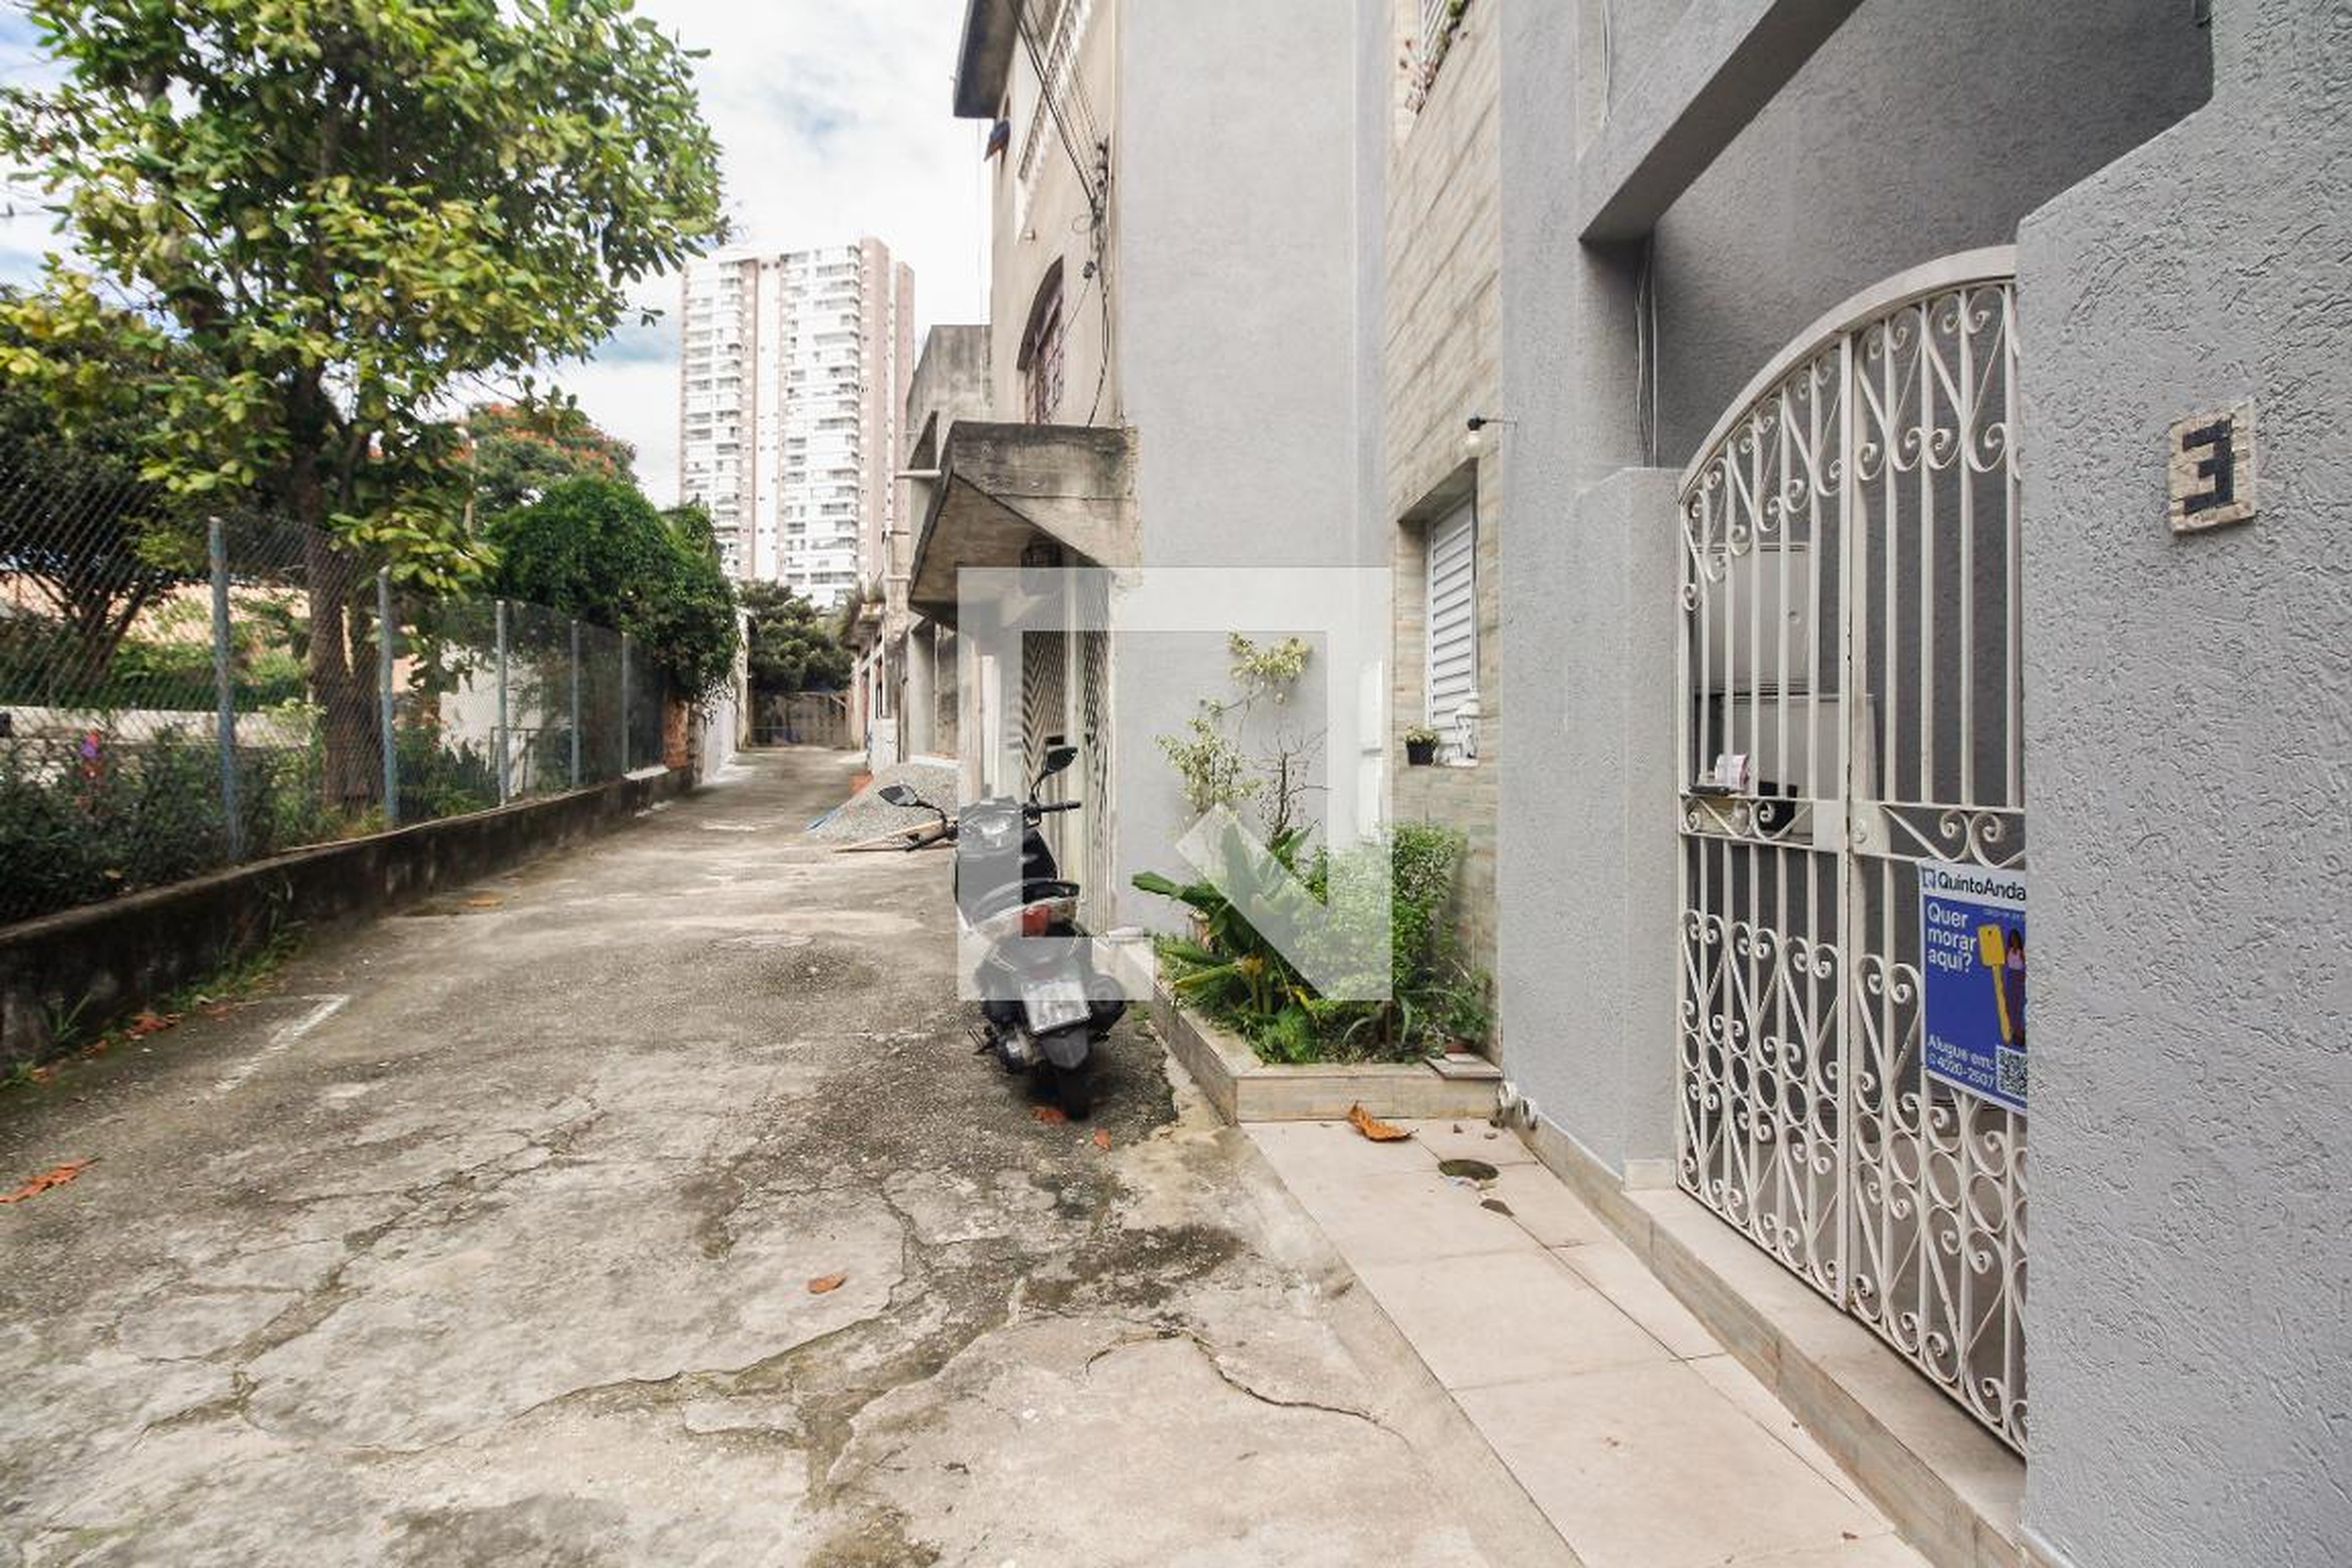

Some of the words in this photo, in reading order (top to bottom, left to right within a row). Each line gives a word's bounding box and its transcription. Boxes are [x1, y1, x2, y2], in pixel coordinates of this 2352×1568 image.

[2182, 418, 2234, 514] 3
[1939, 872, 2026, 900] QuintoAnda
[1928, 902, 1969, 927] Quer
[1928, 928, 1977, 951] morar
[1928, 949, 1973, 973] aqui?
[1928, 1035, 1968, 1062] Alugue
